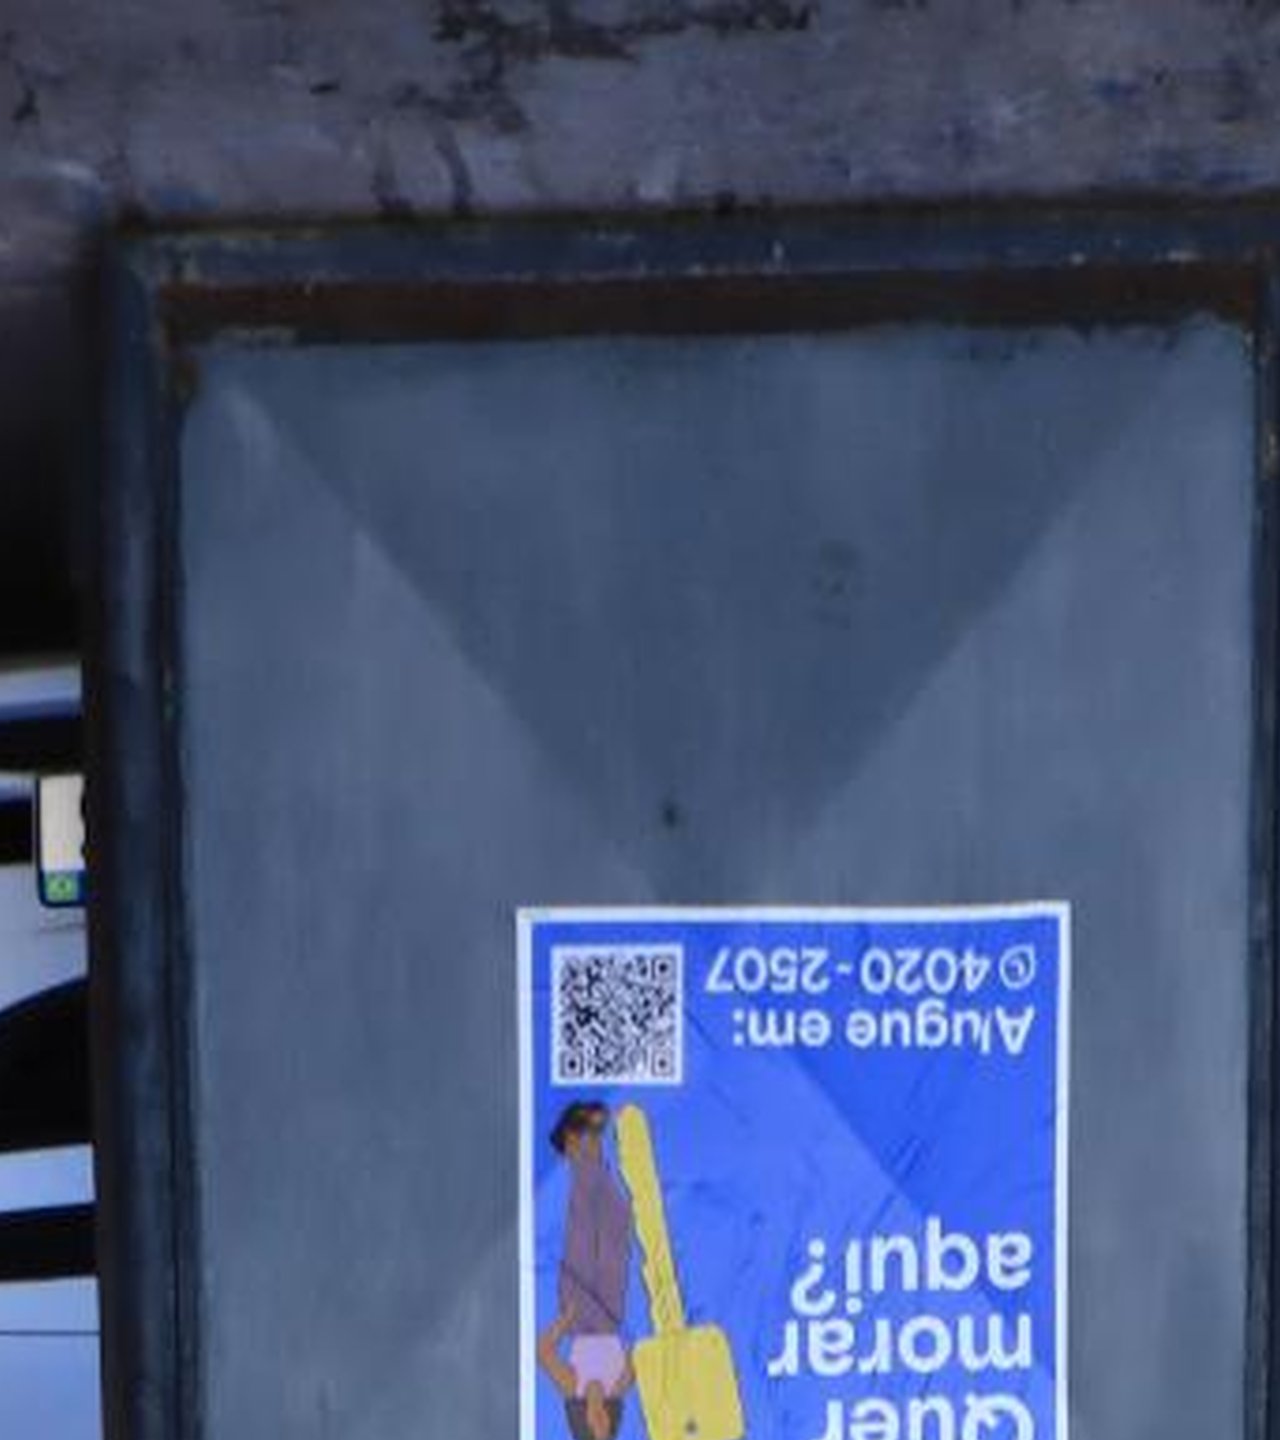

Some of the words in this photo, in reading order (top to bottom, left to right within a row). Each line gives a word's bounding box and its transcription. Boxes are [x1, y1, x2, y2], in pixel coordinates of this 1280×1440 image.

[732, 1006, 832, 1045] em:
[846, 1005, 1035, 1055] Alugue
[790, 1217, 1033, 1316] aqui?
[766, 1313, 1033, 1377] morar
